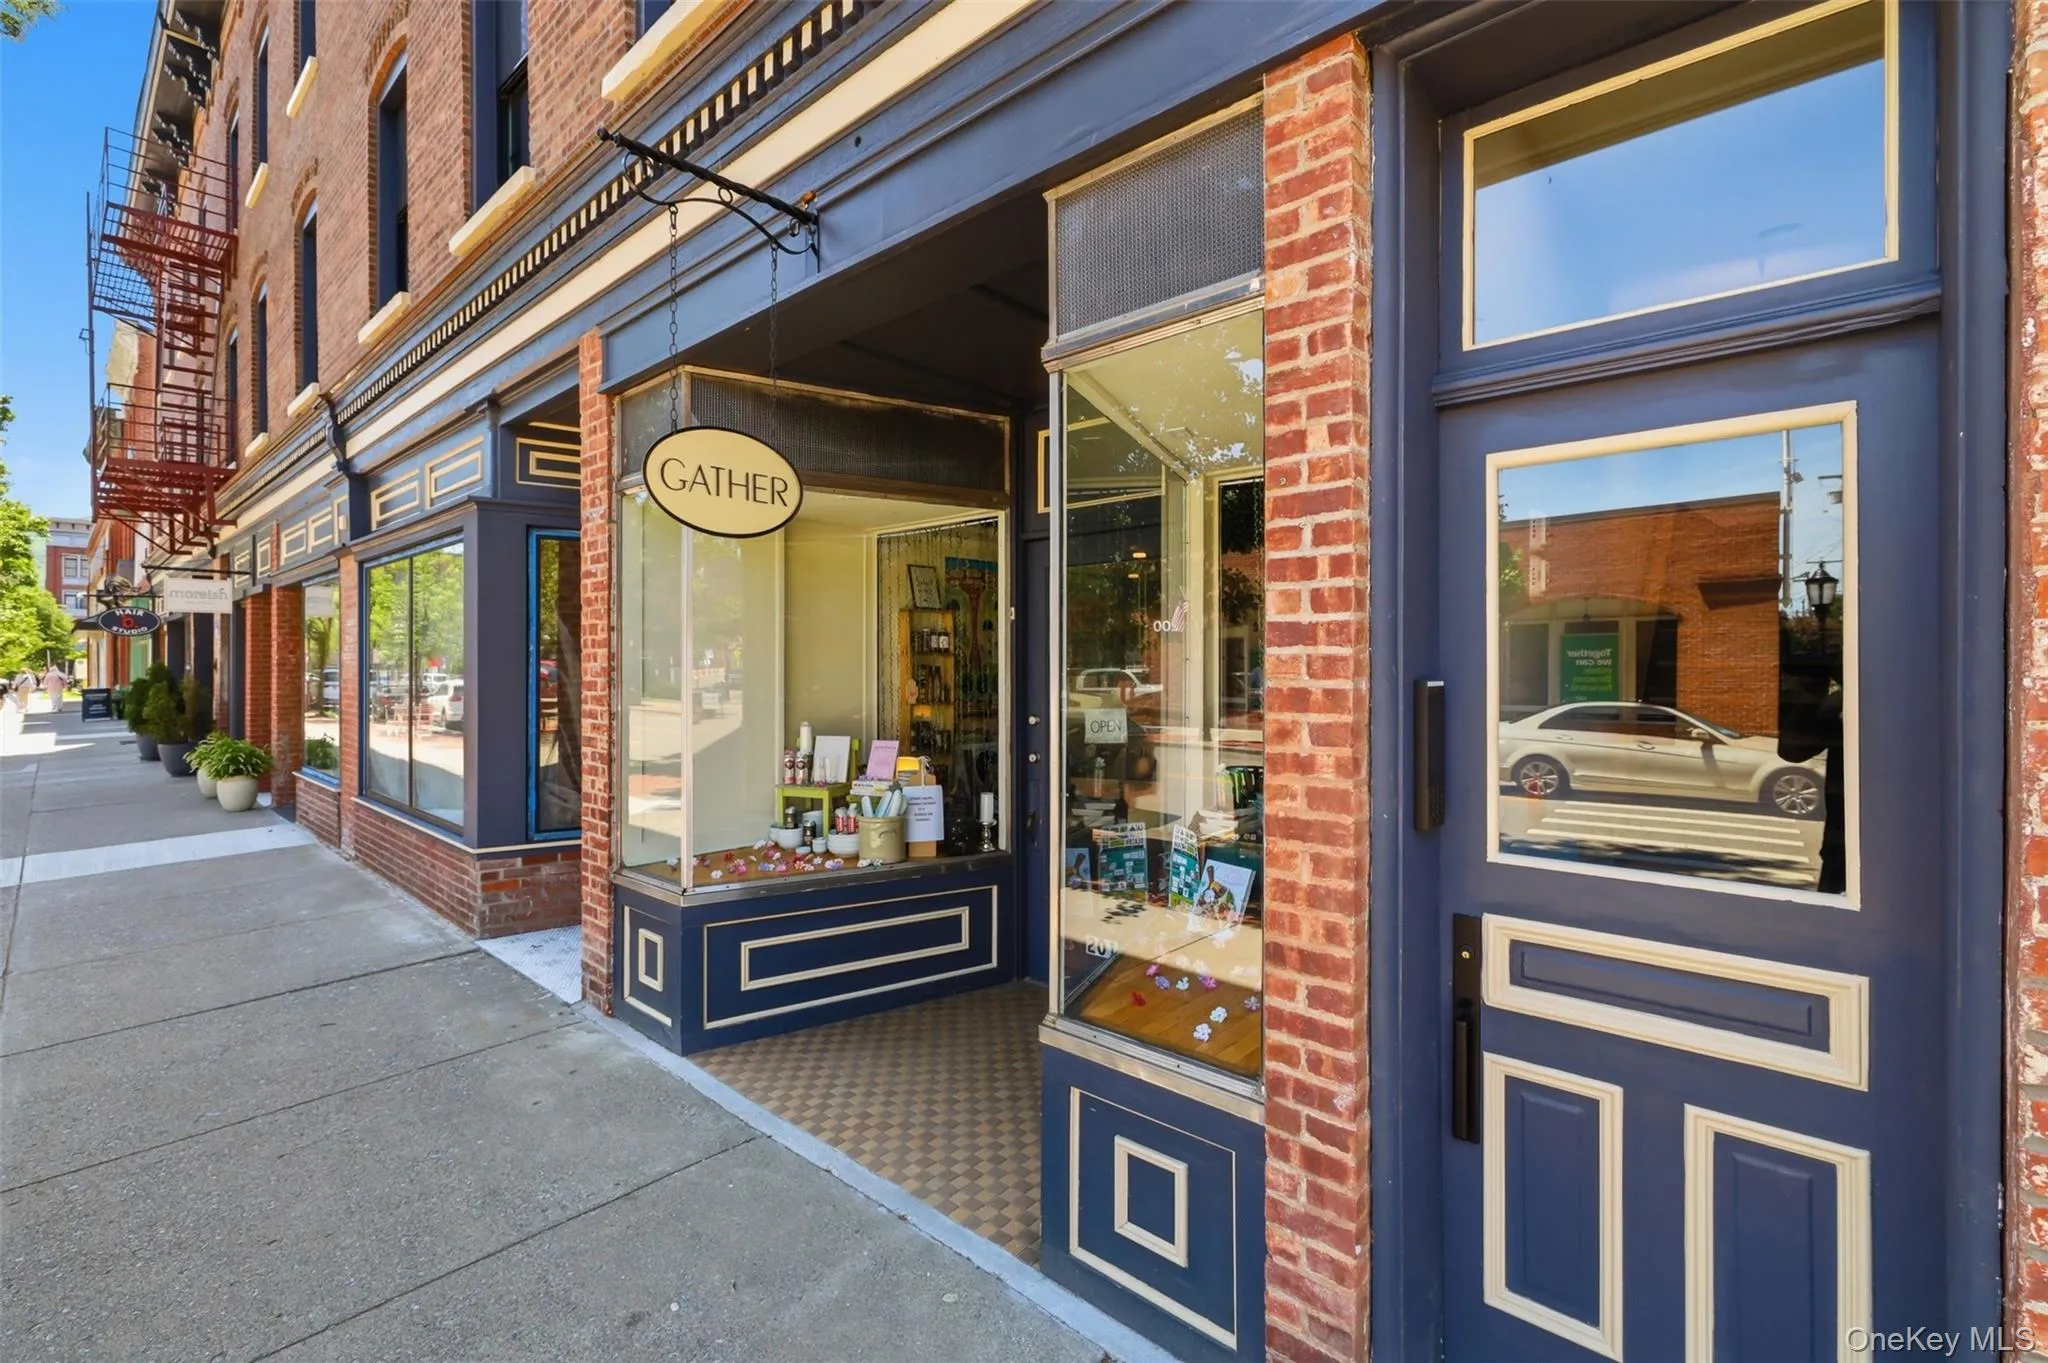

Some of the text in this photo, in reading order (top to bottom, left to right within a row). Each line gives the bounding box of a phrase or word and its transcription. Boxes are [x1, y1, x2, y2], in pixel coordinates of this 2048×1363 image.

[660, 457, 788, 507] GATHER
[168, 588, 228, 600] moreish
[115, 608, 144, 617] HAIR
[112, 625, 148, 635] STUDIO
[1090, 719, 1123, 734] OPEN
